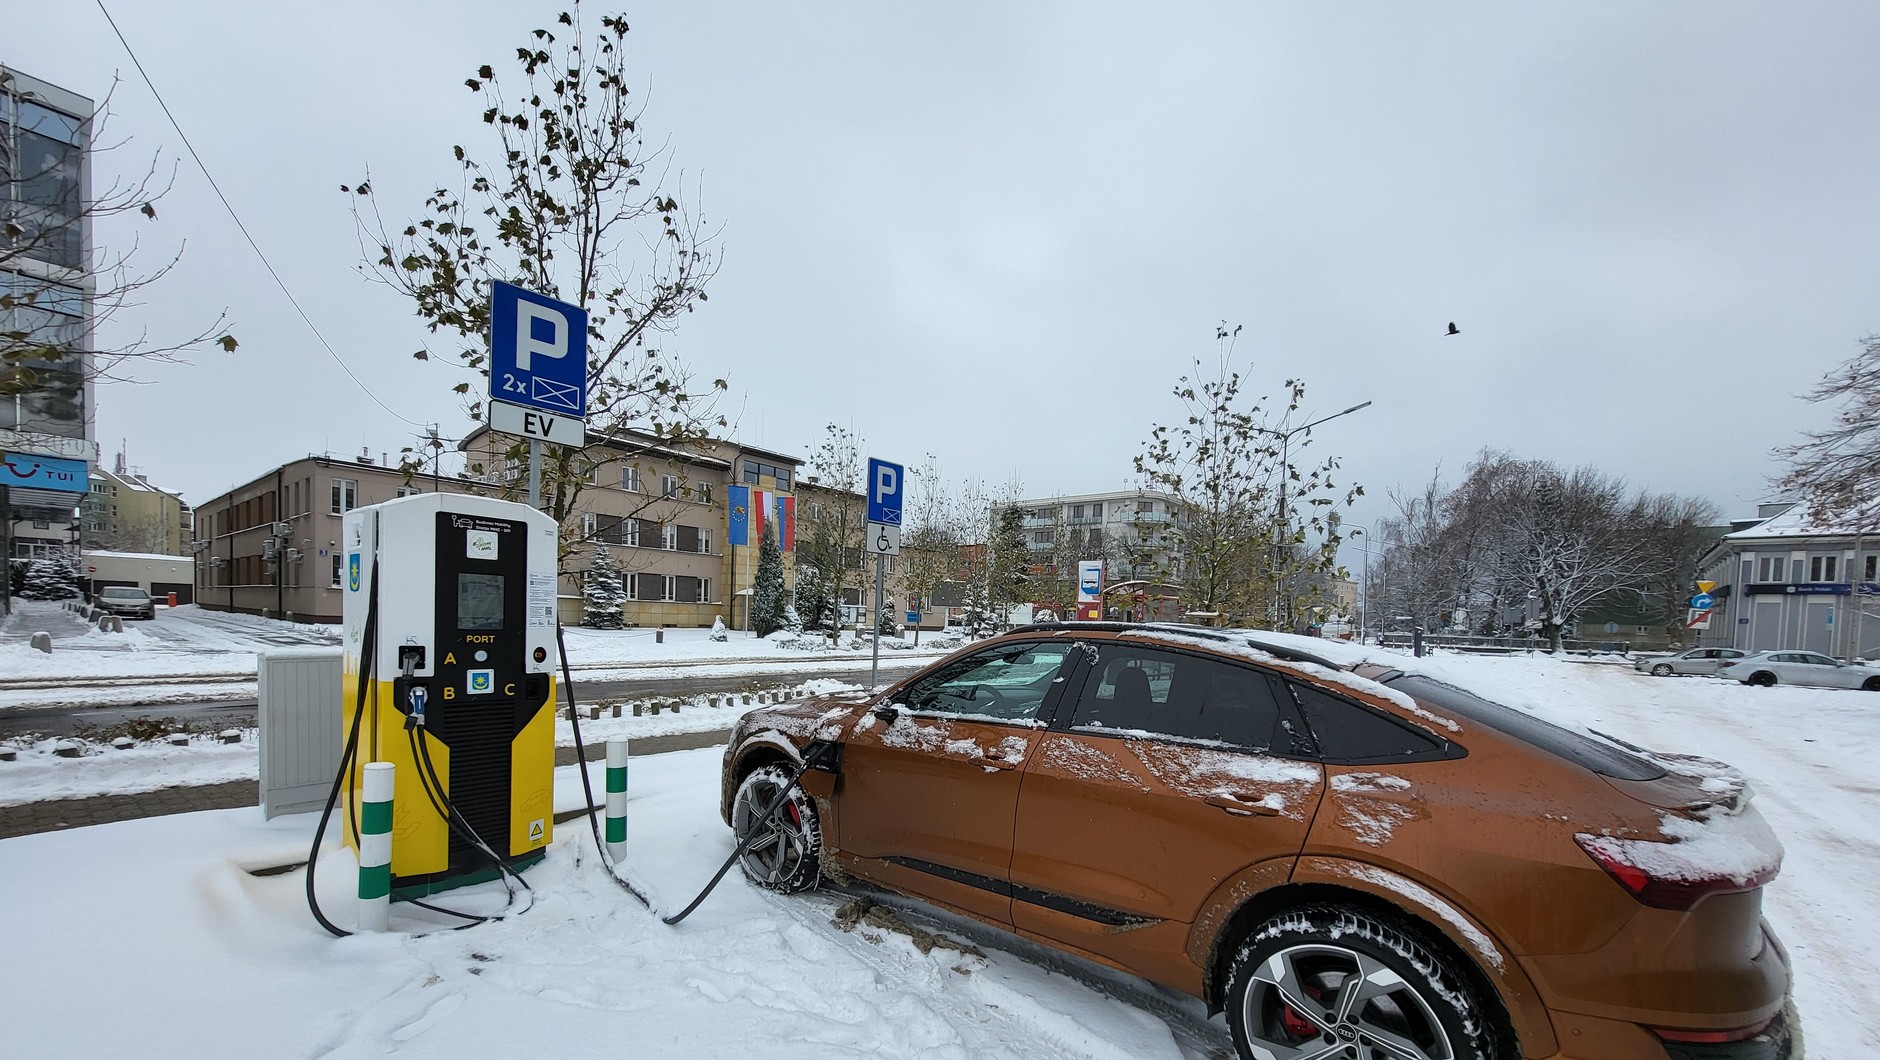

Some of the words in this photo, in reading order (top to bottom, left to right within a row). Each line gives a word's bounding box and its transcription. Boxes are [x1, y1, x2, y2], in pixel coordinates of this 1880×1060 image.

[516, 298, 569, 371] P
[502, 373, 527, 395] 2x
[524, 411, 554, 437] EV
[46, 471, 73, 481] TUI
[877, 465, 896, 503] P
[466, 635, 496, 643] PORT
[444, 652, 456, 664] A
[444, 687, 455, 699] B
[504, 684, 515, 695] C
